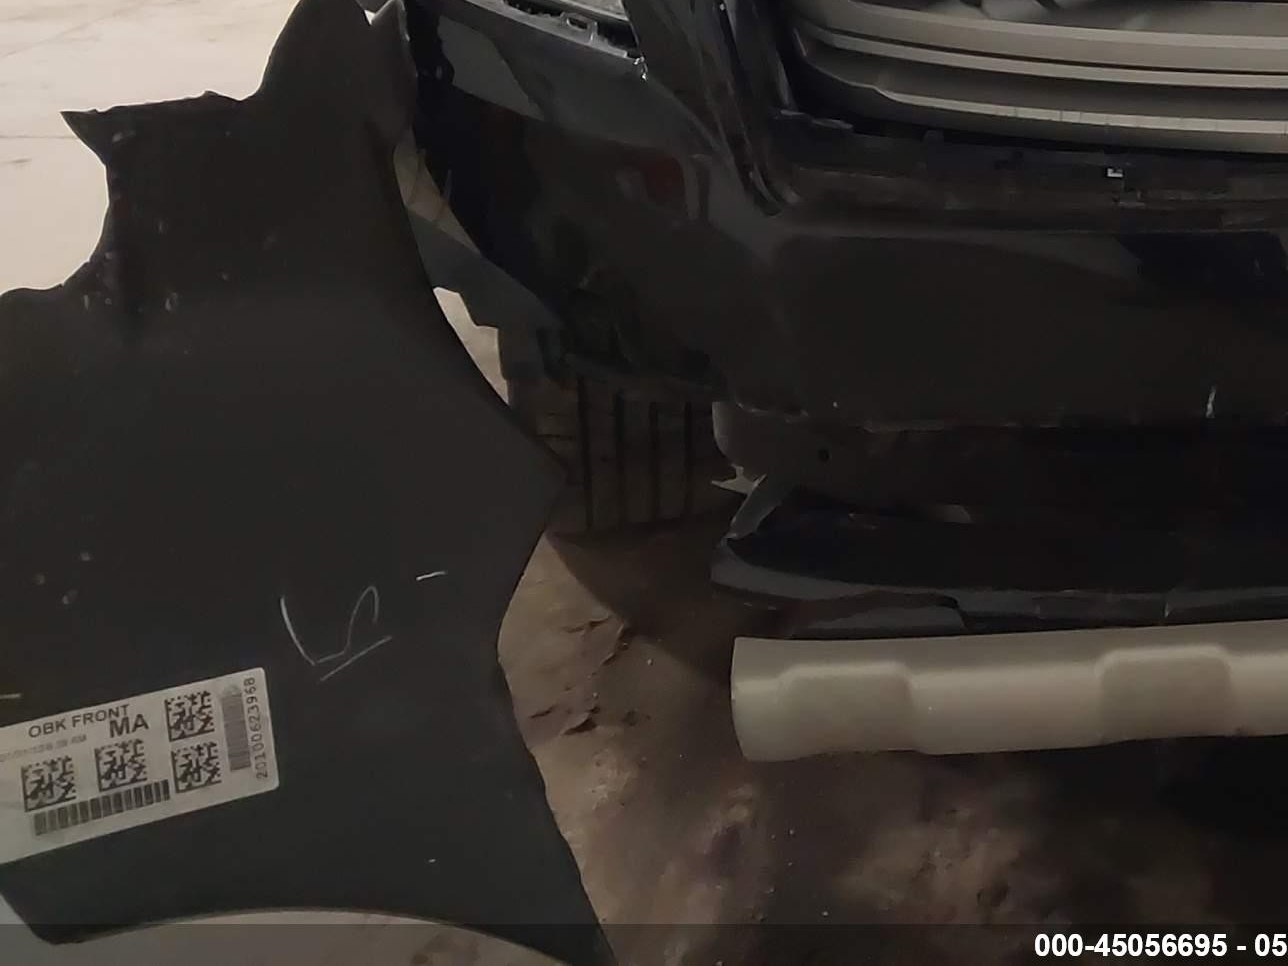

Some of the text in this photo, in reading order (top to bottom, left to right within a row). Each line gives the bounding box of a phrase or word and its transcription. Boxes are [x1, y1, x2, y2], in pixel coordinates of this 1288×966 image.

[28, 703, 130, 738] OBK FRONT
[109, 713, 150, 738] MA
